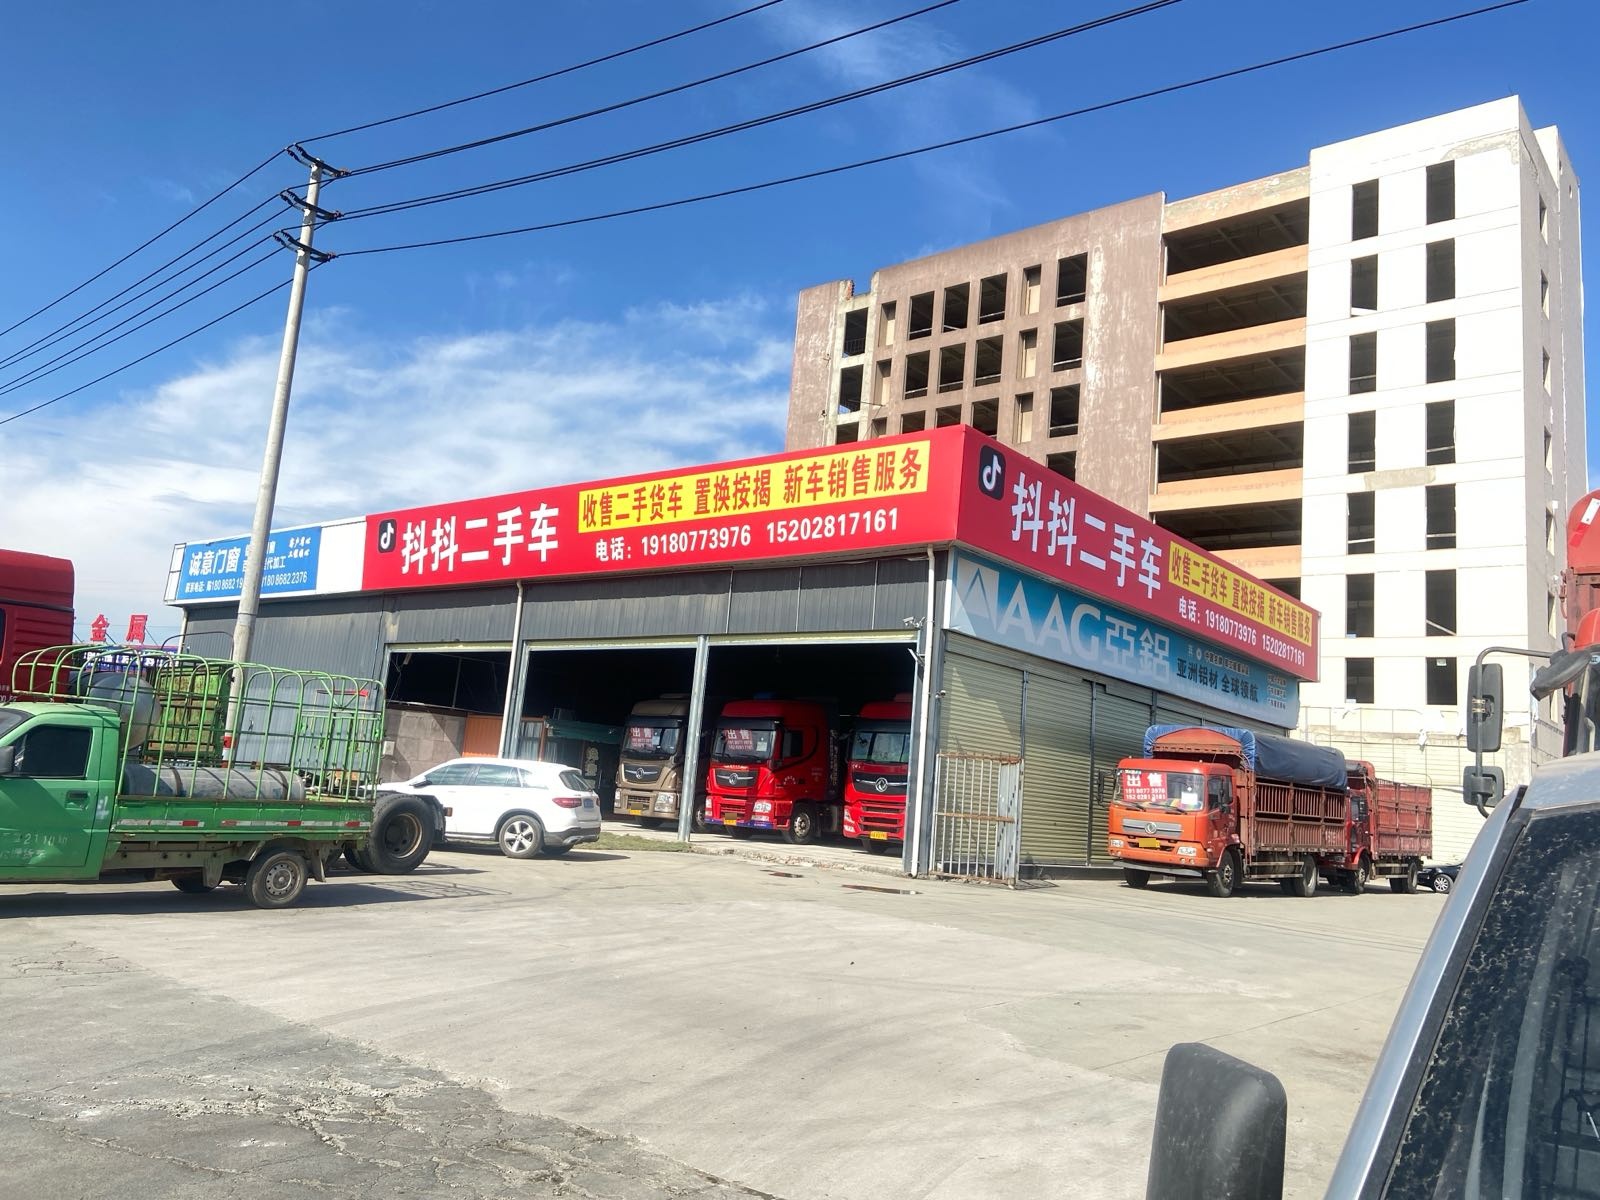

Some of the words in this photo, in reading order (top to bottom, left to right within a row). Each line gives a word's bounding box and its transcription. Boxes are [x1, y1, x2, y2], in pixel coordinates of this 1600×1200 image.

[583, 482, 683, 528] 收售二手货车
[694, 469, 771, 516] 置换按揭
[783, 447, 922, 504] 新车销售服务
[401, 502, 559, 575] 抖抖二手车
[641, 524, 751, 556] 19180773976
[767, 507, 898, 544] 15202817161
[1011, 472, 1162, 599] 抖抖二手车
[188, 546, 241, 577] 诚意门窗
[1172, 547, 1228, 603] 收售二手货车
[1231, 578, 1265, 621] 置换按揭
[1268, 596, 1311, 643] 新车销售服务
[1205, 609, 1257, 646] 19180773976
[1262, 633, 1305, 667] 15202817161
[1176, 657, 1218, 690] 亚洲铝材
[1221, 673, 1259, 703] 全球领航
[1126, 772, 1162, 787] 出售
